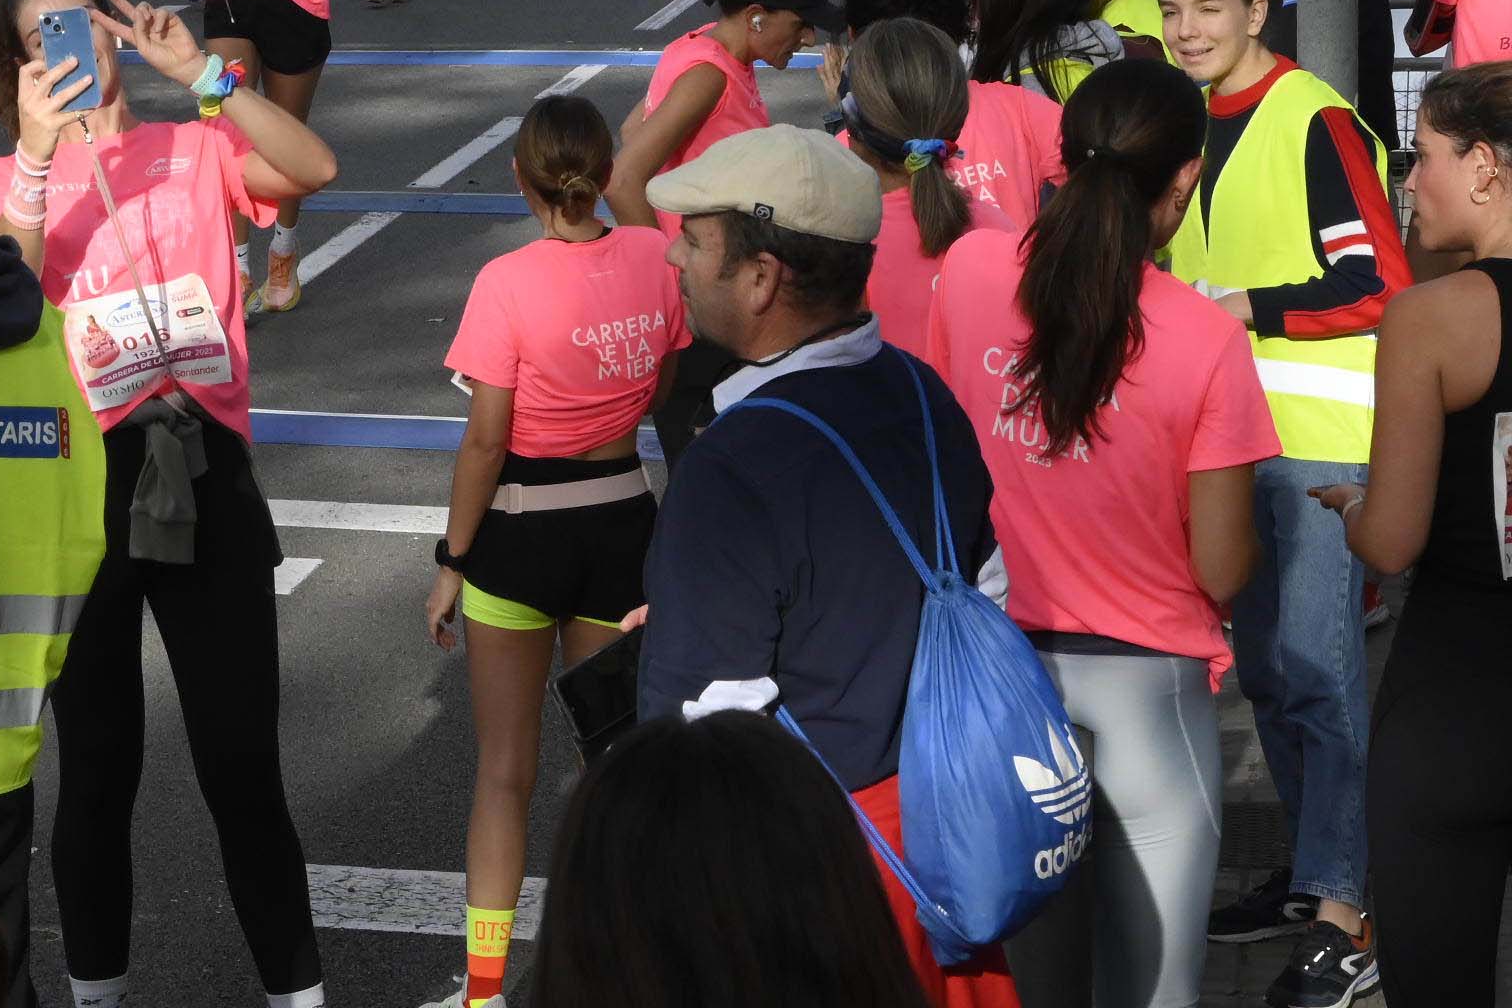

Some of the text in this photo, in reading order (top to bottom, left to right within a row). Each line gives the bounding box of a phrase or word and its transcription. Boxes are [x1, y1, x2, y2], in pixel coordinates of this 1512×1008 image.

[64, 264, 110, 301] TU
[123, 327, 171, 351] 016
[571, 309, 666, 347] CARRERA
[101, 365, 140, 384] CARRERA
[140, 361, 153, 371] DE
[154, 356, 165, 367] LA
[174, 364, 220, 379] Santander
[102, 380, 145, 399] OYSHO
